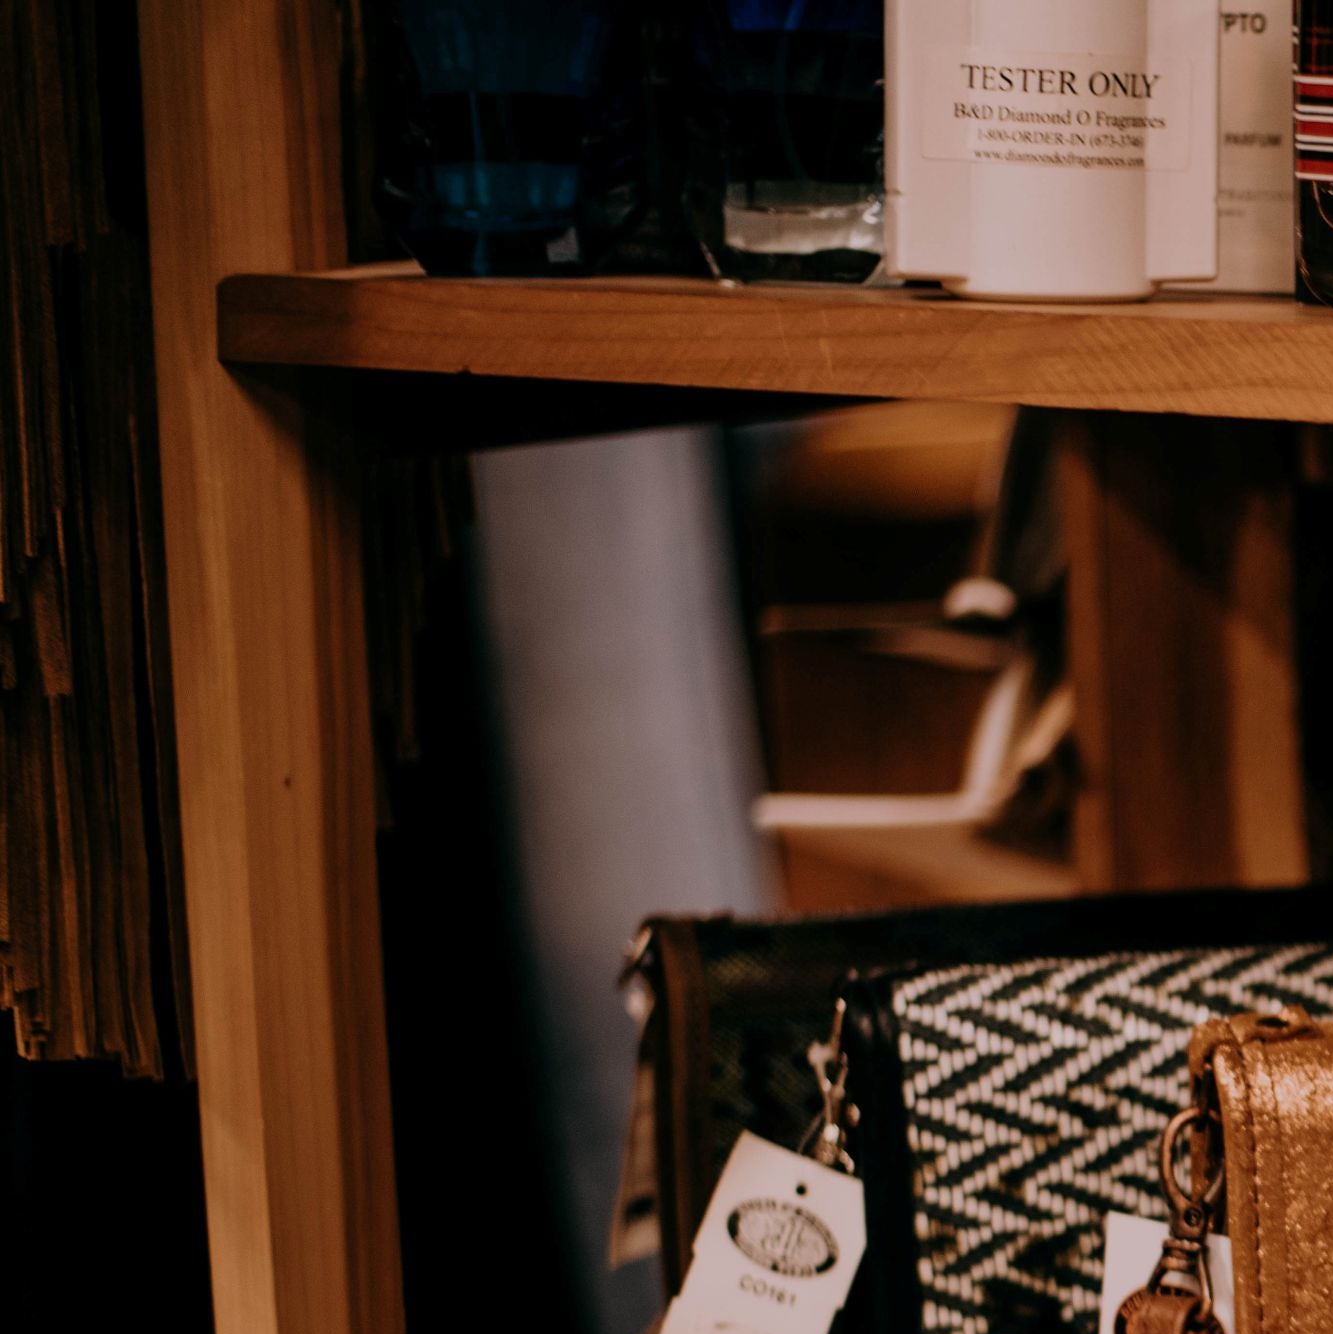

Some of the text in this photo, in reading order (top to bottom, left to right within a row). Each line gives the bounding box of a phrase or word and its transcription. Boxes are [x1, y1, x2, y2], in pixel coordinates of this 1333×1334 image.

[1221, 12, 1268, 34] PTO
[960, 62, 1162, 99] TESTER ONLY
[953, 102, 994, 121] B&D
[997, 105, 1072, 126] Diamond
[1076, 109, 1092, 126] O
